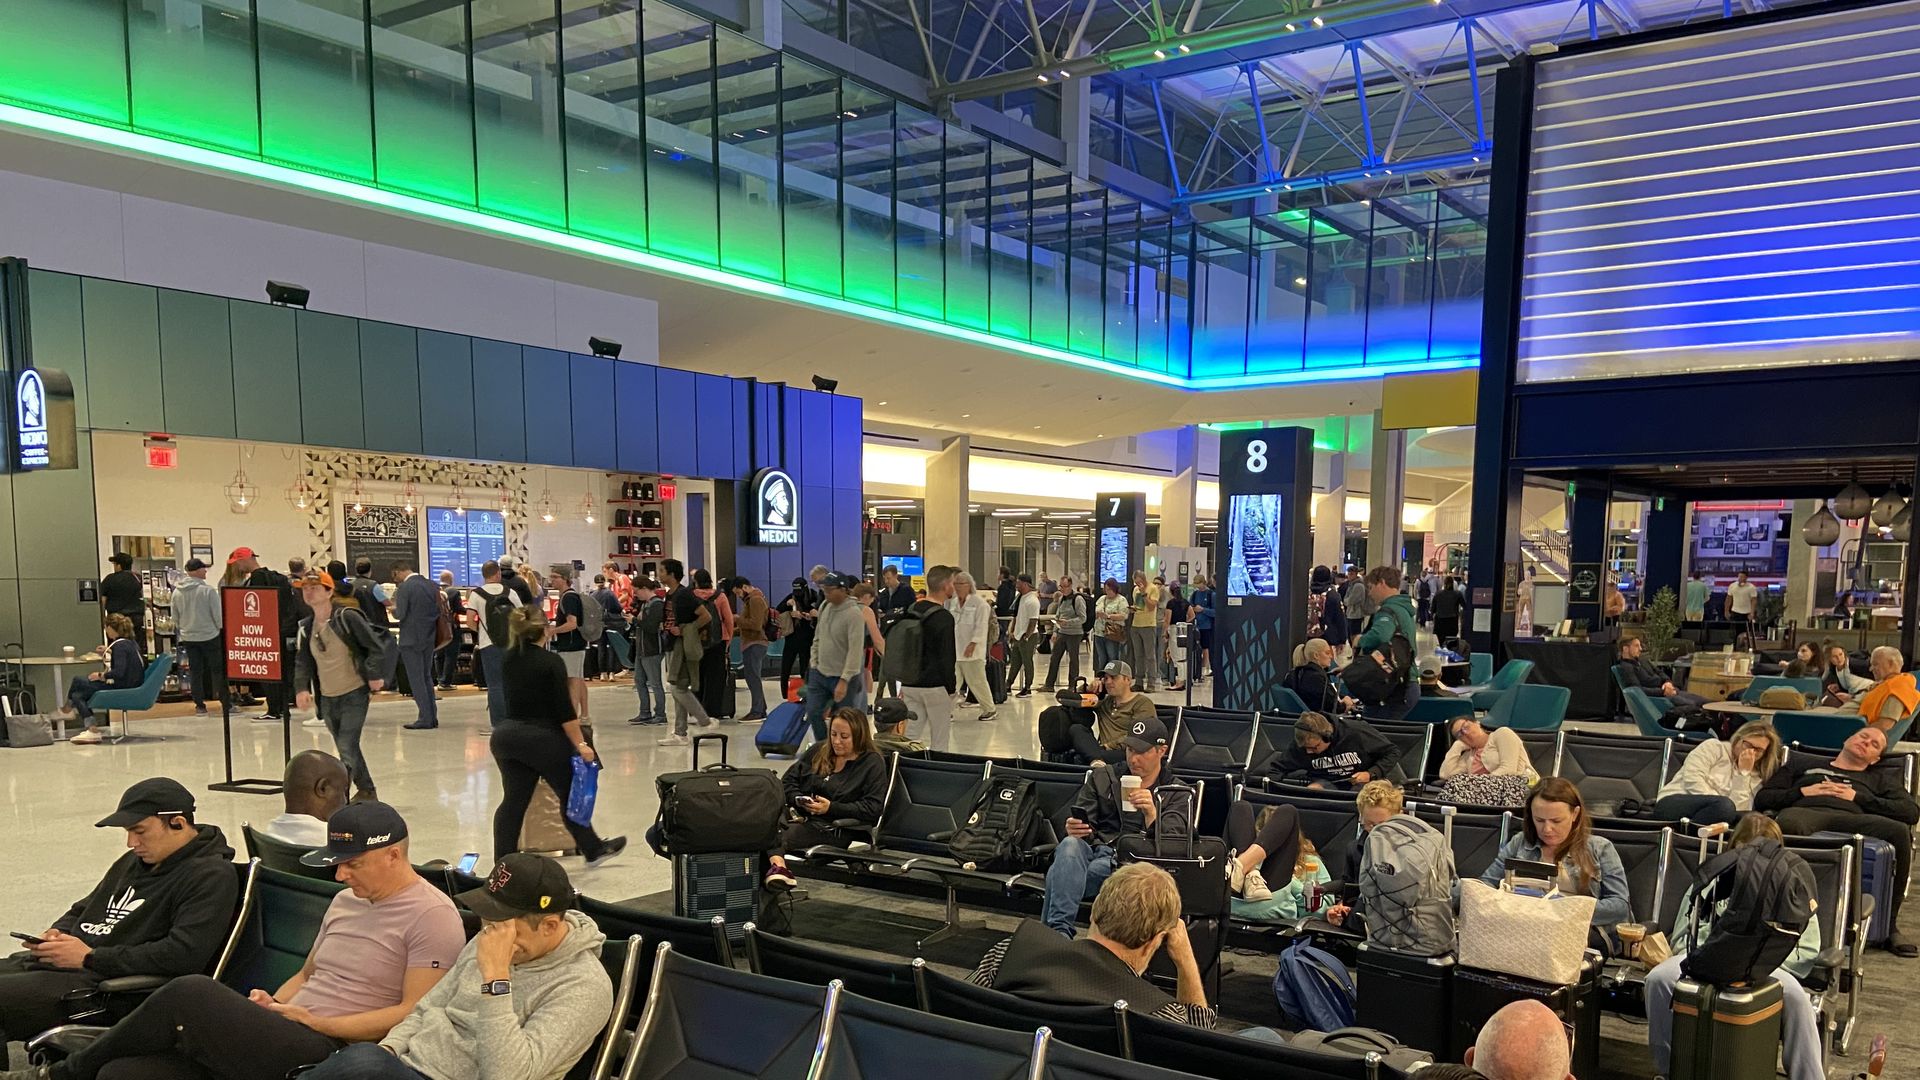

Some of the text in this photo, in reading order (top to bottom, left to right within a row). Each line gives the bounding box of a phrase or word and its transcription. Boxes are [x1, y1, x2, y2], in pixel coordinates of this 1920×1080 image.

[1246, 439, 1268, 473] 8
[1109, 497, 1120, 516] 7
[759, 529, 797, 543] MEDICI
[910, 540, 917, 551] 5
[241, 624, 263, 635] NOW
[234, 636, 272, 648] SERVING
[228, 650, 279, 662] BREAKFAST
[239, 664, 268, 675] TACOS
[366, 832, 391, 845] telcel
